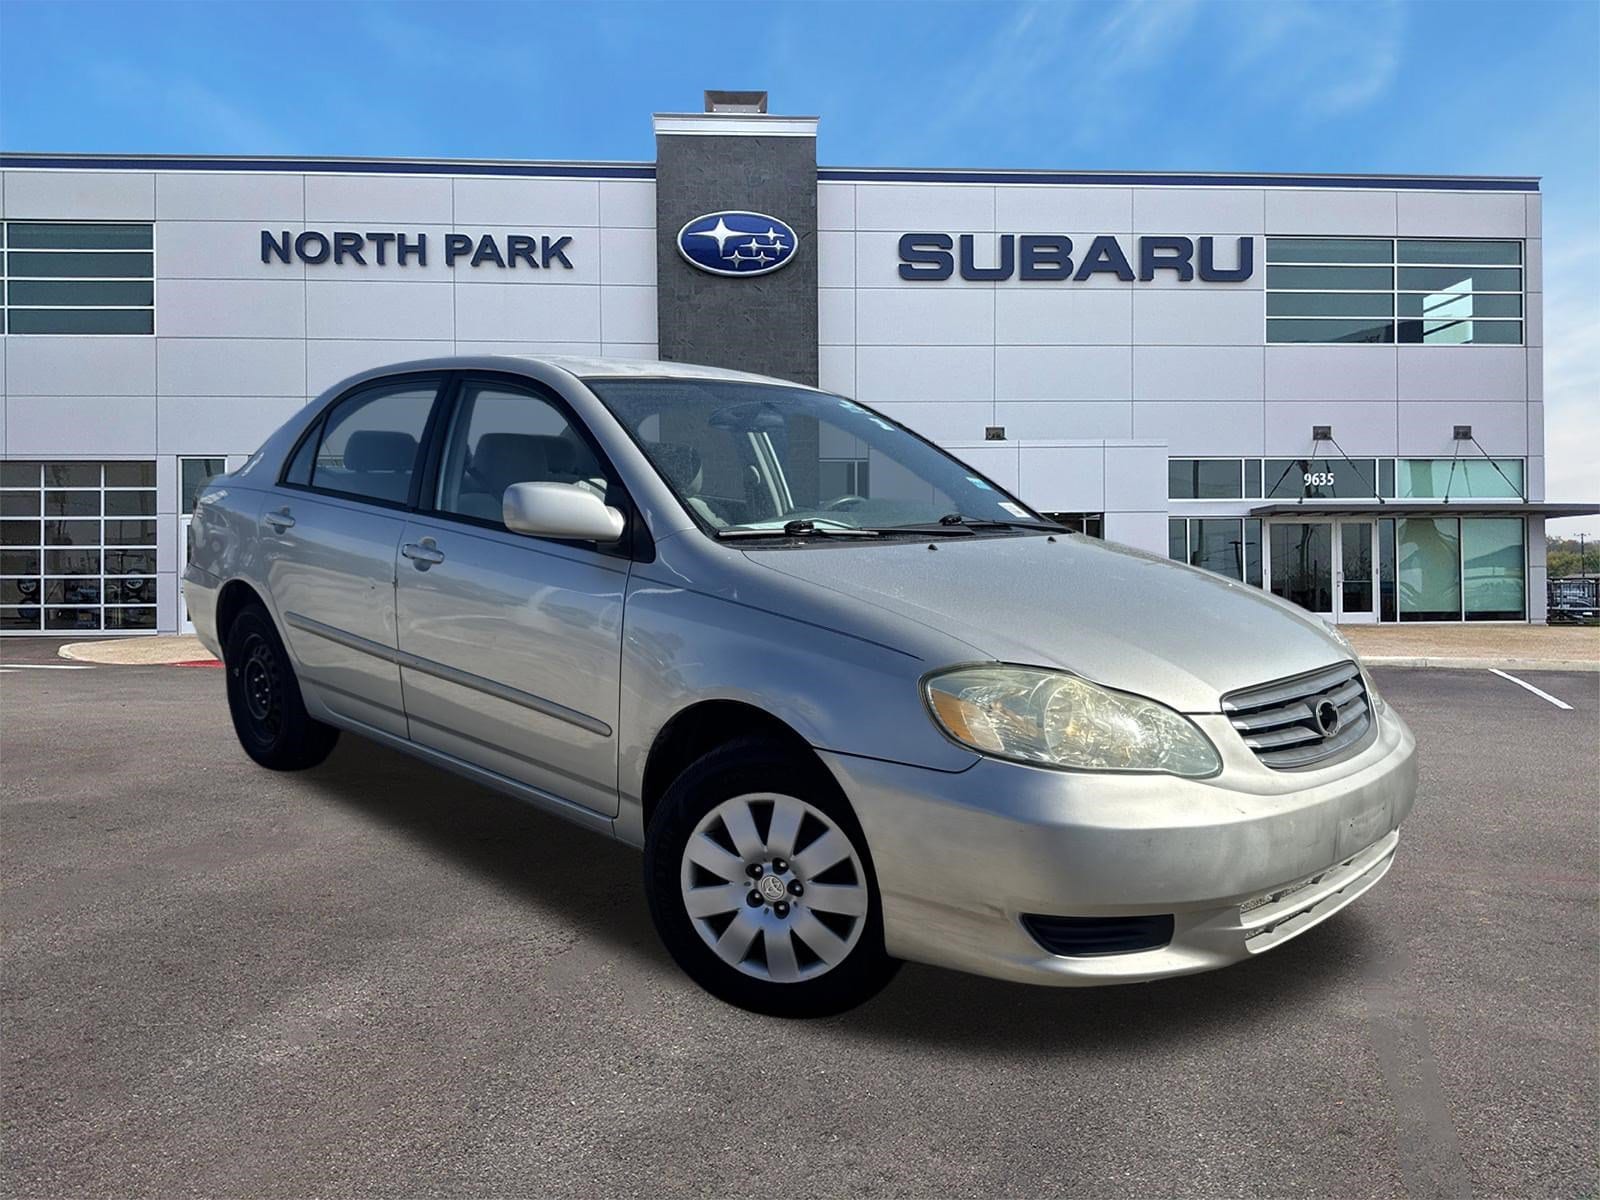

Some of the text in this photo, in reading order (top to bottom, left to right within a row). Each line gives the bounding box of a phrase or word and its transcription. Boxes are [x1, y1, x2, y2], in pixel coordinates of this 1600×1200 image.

[261, 230, 574, 269] NORTH PARK
[898, 233, 1254, 282] SUBARU
[1304, 472, 1334, 486] 9635
